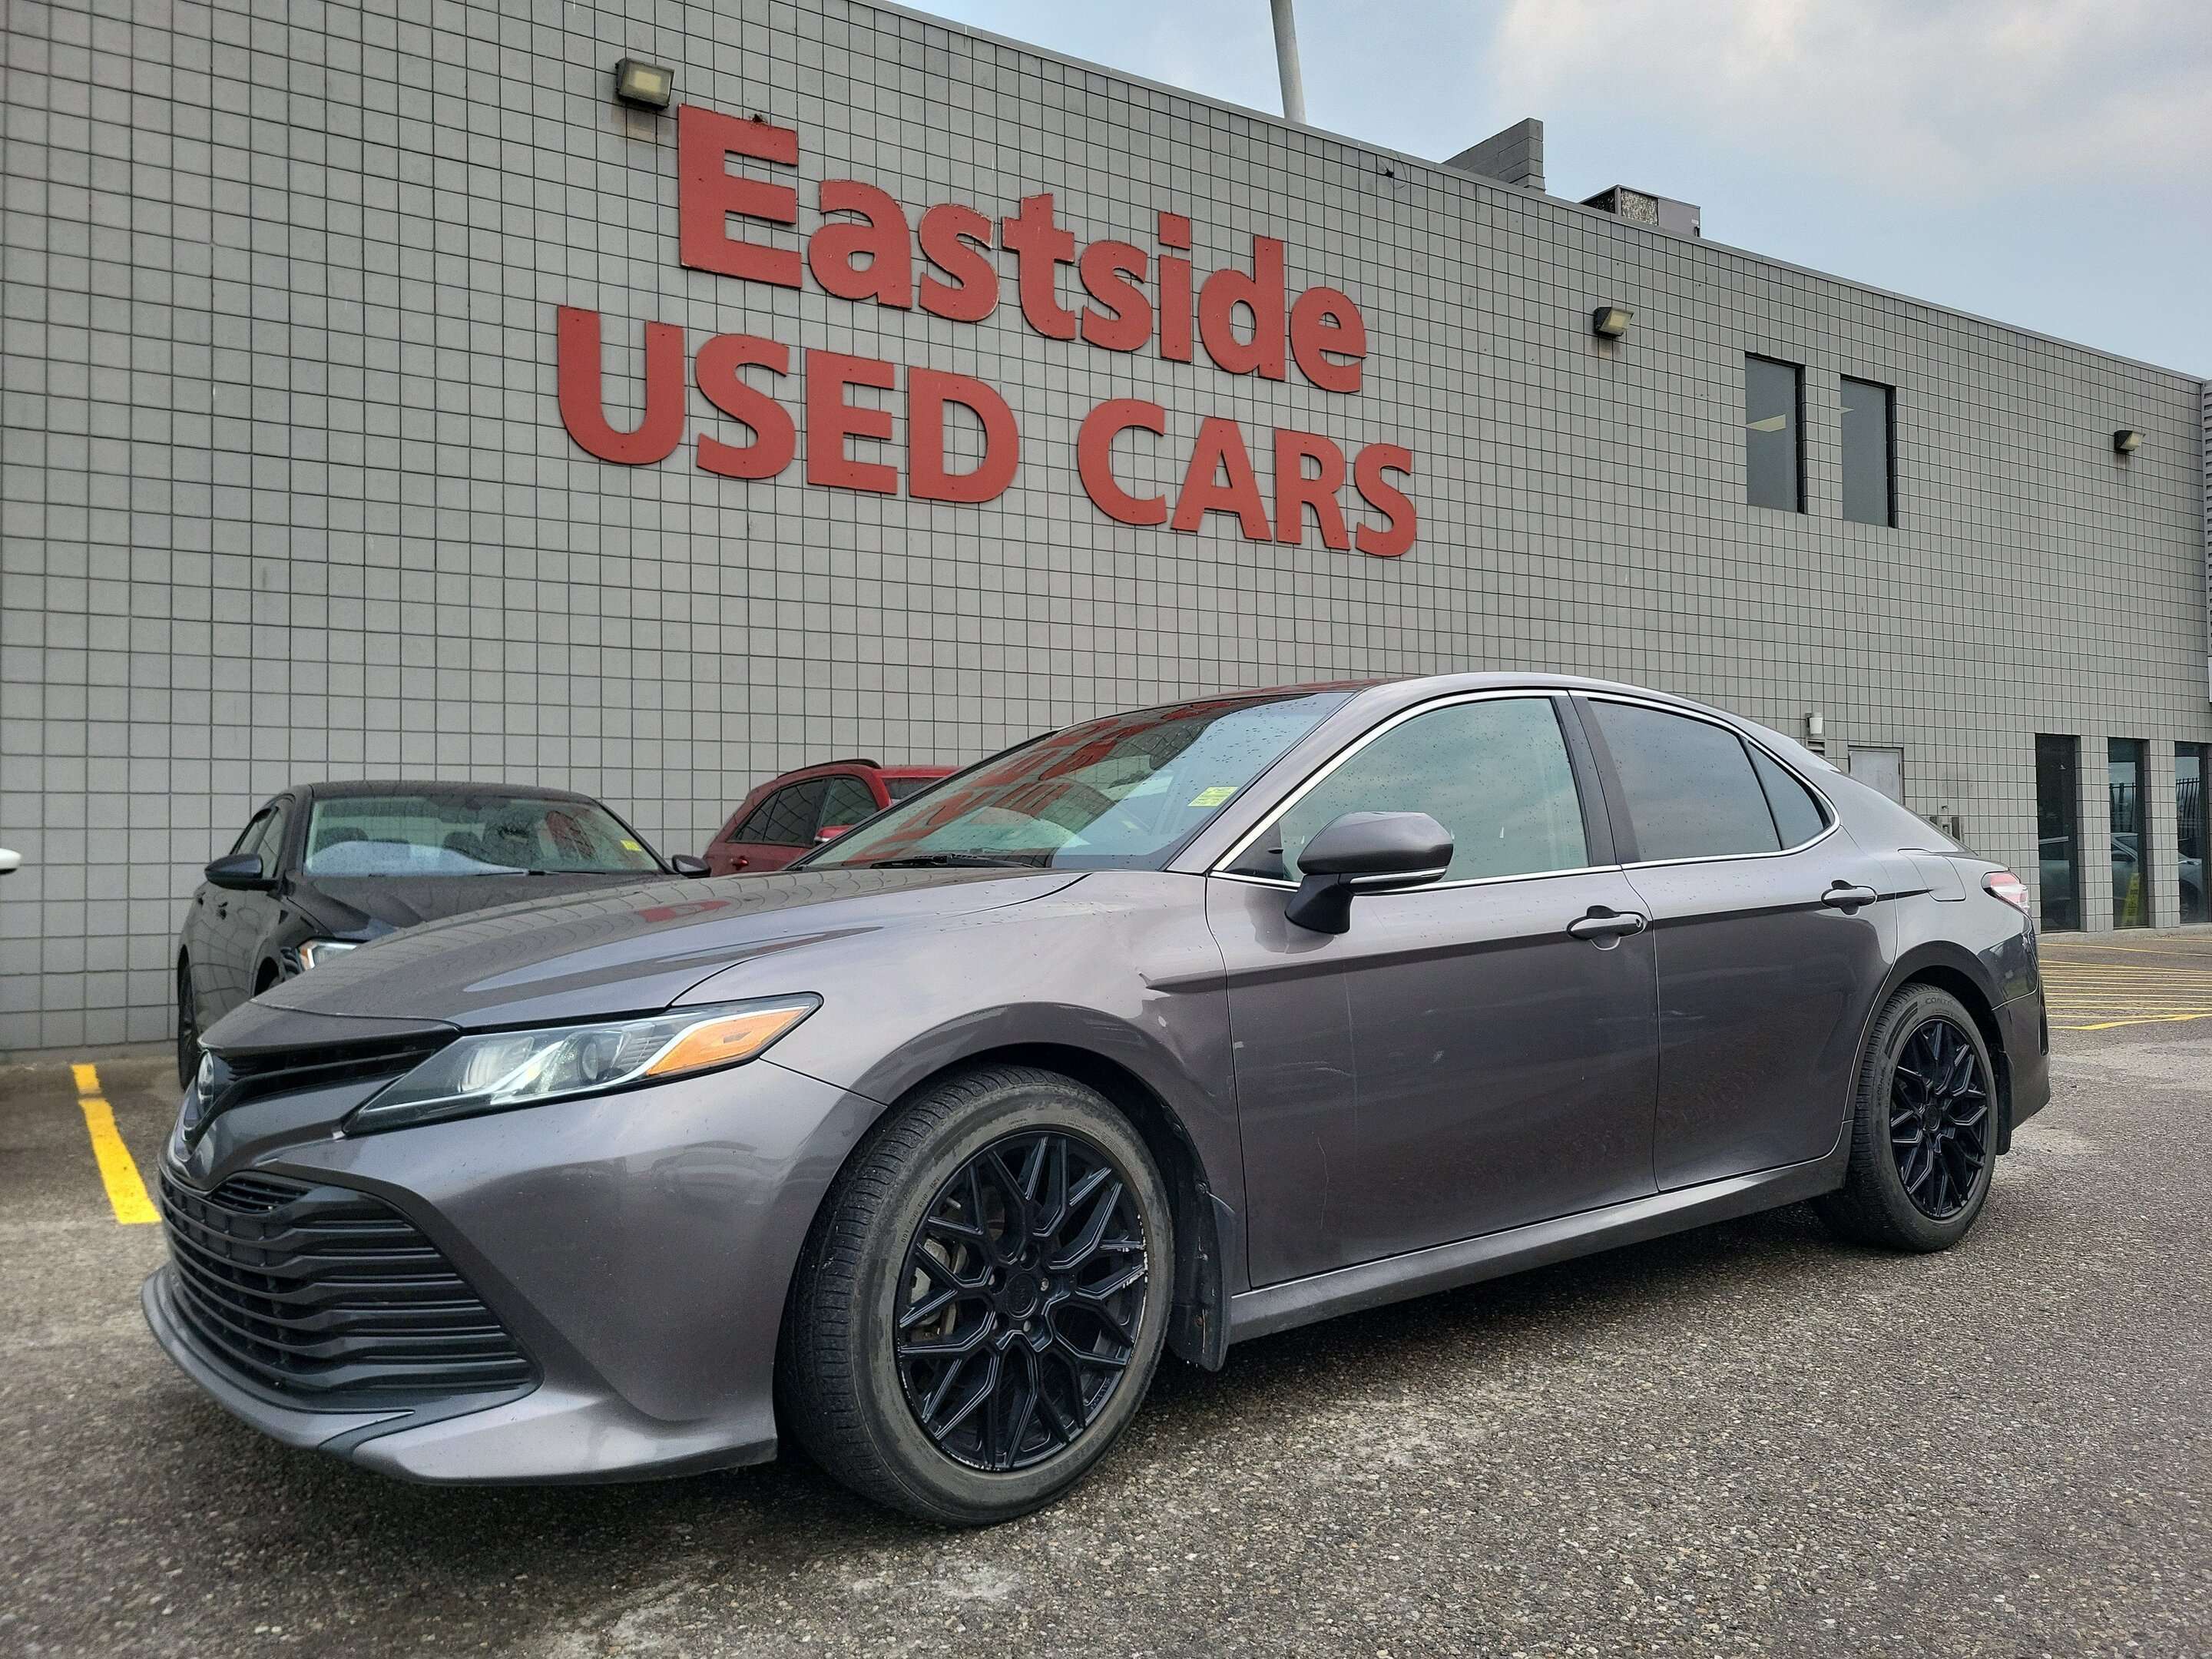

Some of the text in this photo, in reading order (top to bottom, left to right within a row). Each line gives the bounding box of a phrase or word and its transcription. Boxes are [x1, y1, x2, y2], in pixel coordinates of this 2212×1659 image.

[678, 104, 1367, 393] Eastside
[558, 306, 1417, 557] USED CARS
